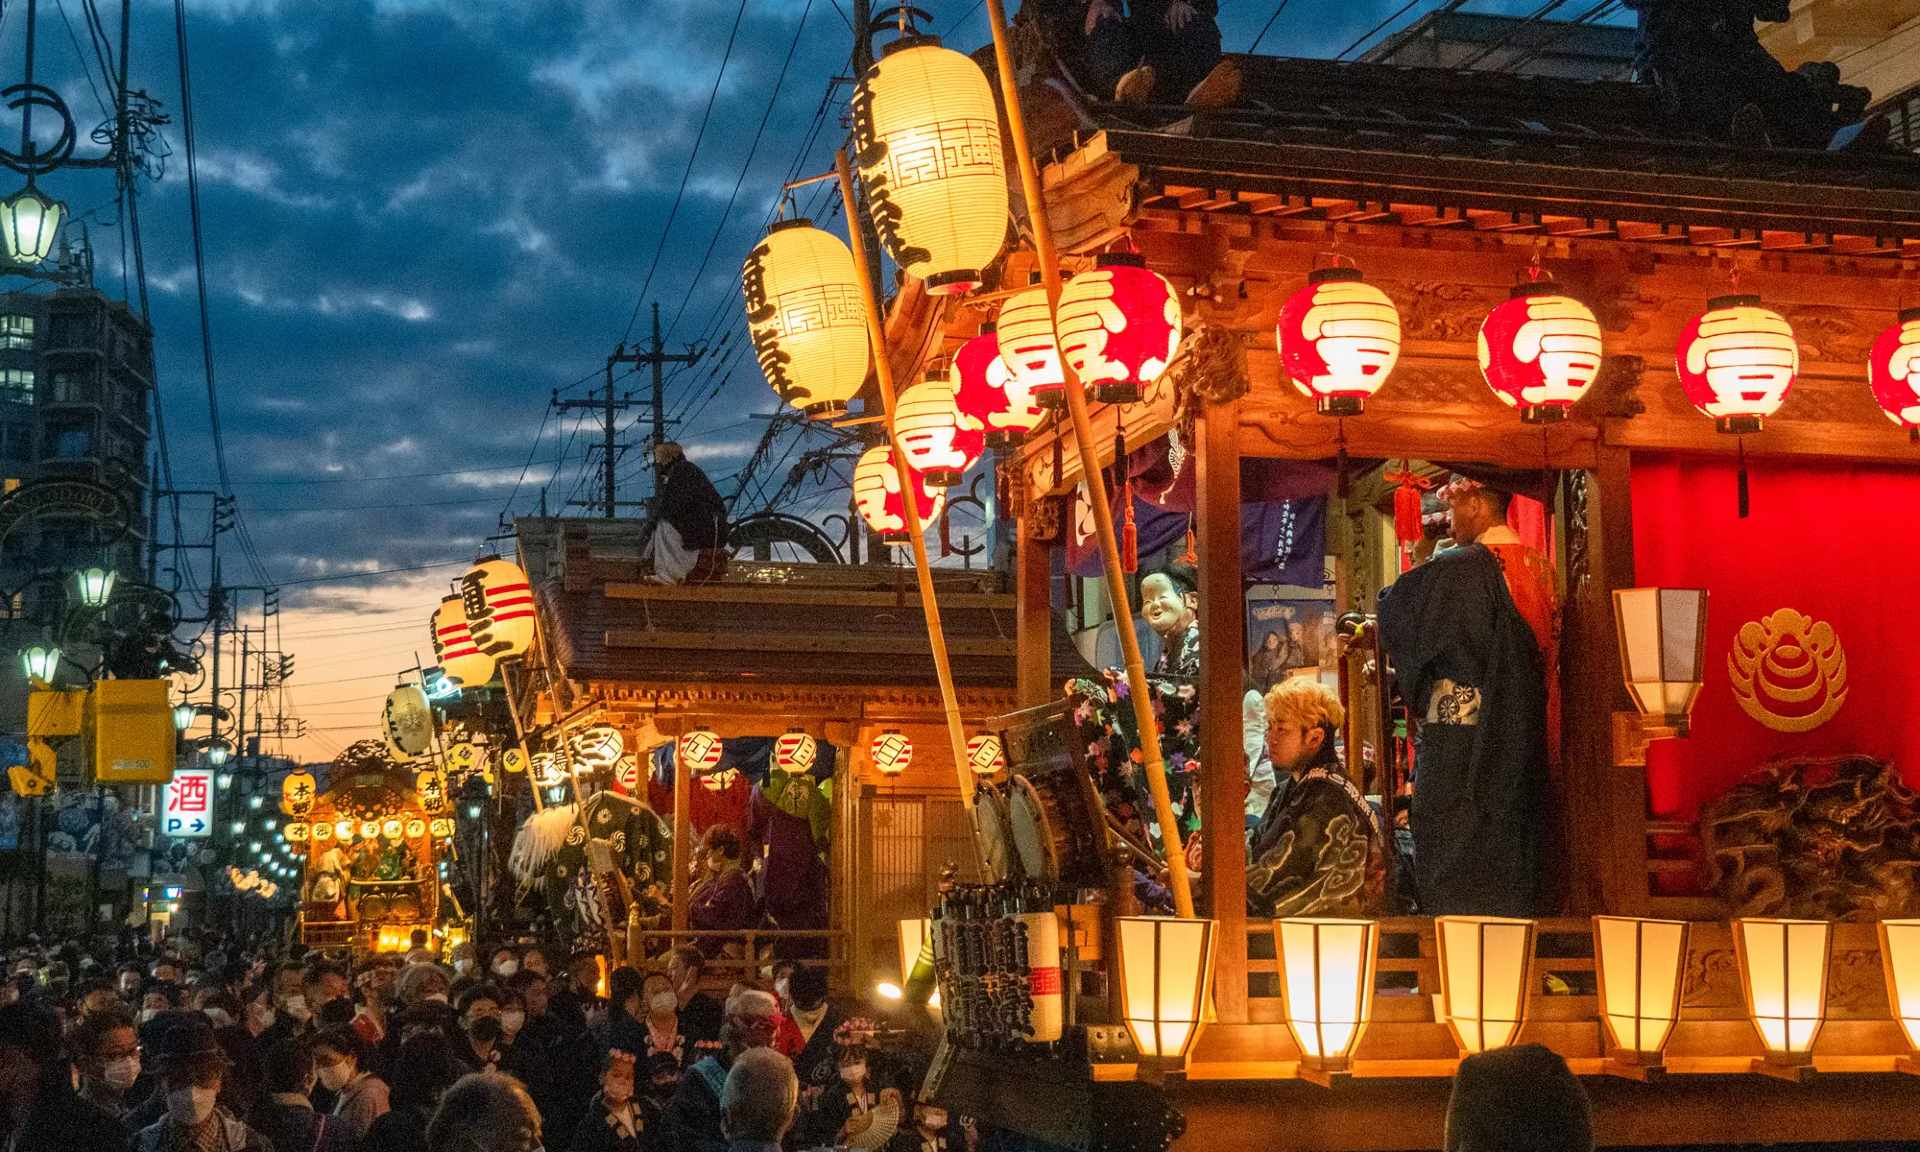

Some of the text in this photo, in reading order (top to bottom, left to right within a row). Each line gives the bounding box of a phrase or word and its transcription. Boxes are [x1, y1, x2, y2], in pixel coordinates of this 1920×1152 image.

[169, 776, 208, 811] 酒
[293, 783, 310, 814] 本郷
[424, 777, 443, 812] 本郷
[168, 818, 181, 832] P
